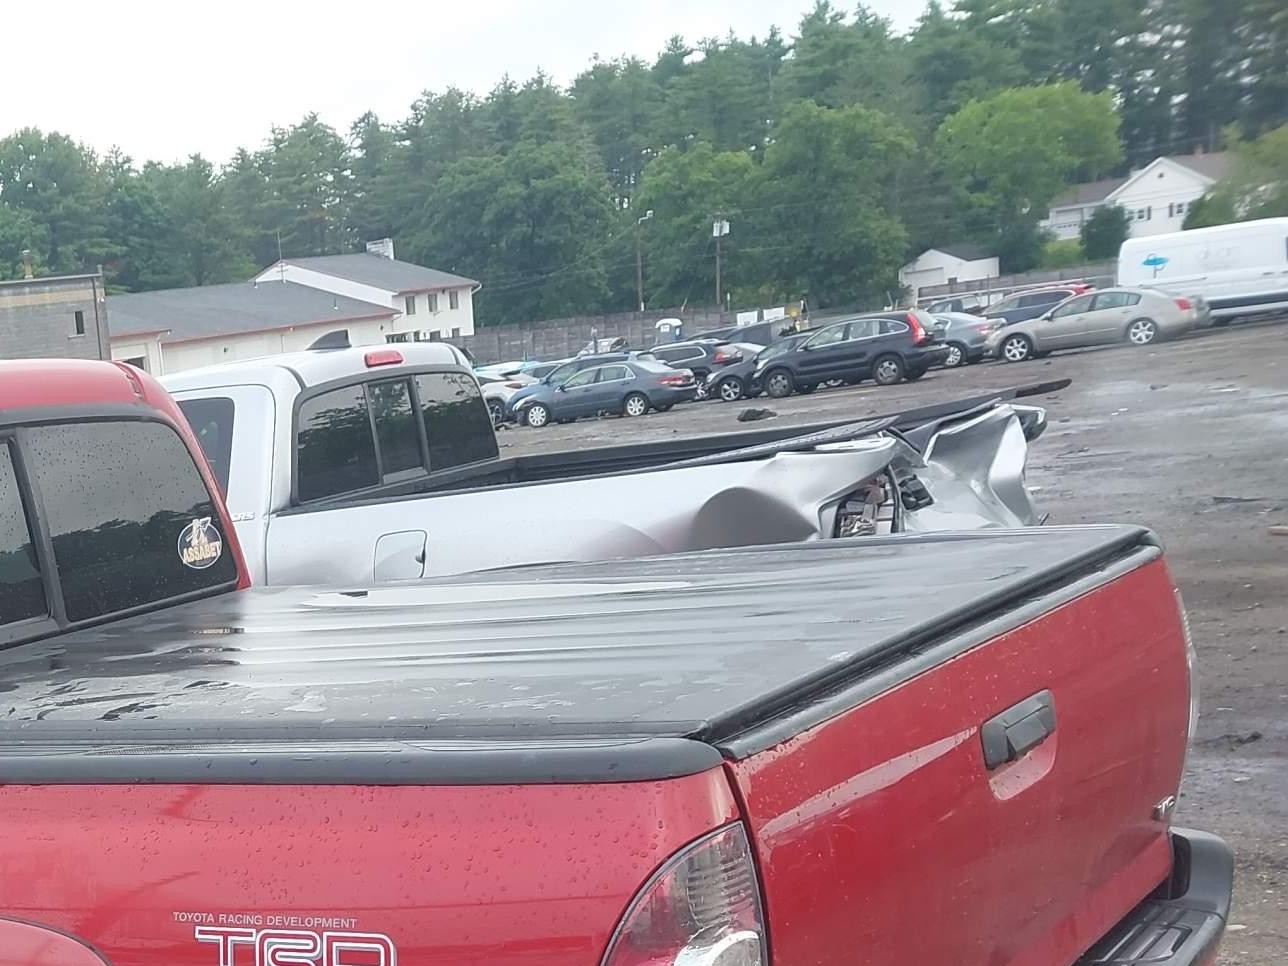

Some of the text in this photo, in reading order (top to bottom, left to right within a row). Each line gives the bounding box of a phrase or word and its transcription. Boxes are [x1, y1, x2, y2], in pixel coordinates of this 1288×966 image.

[183, 541, 220, 563] ASSABET
[173, 912, 358, 929] TOYOTA RACING DEVELOPMENT
